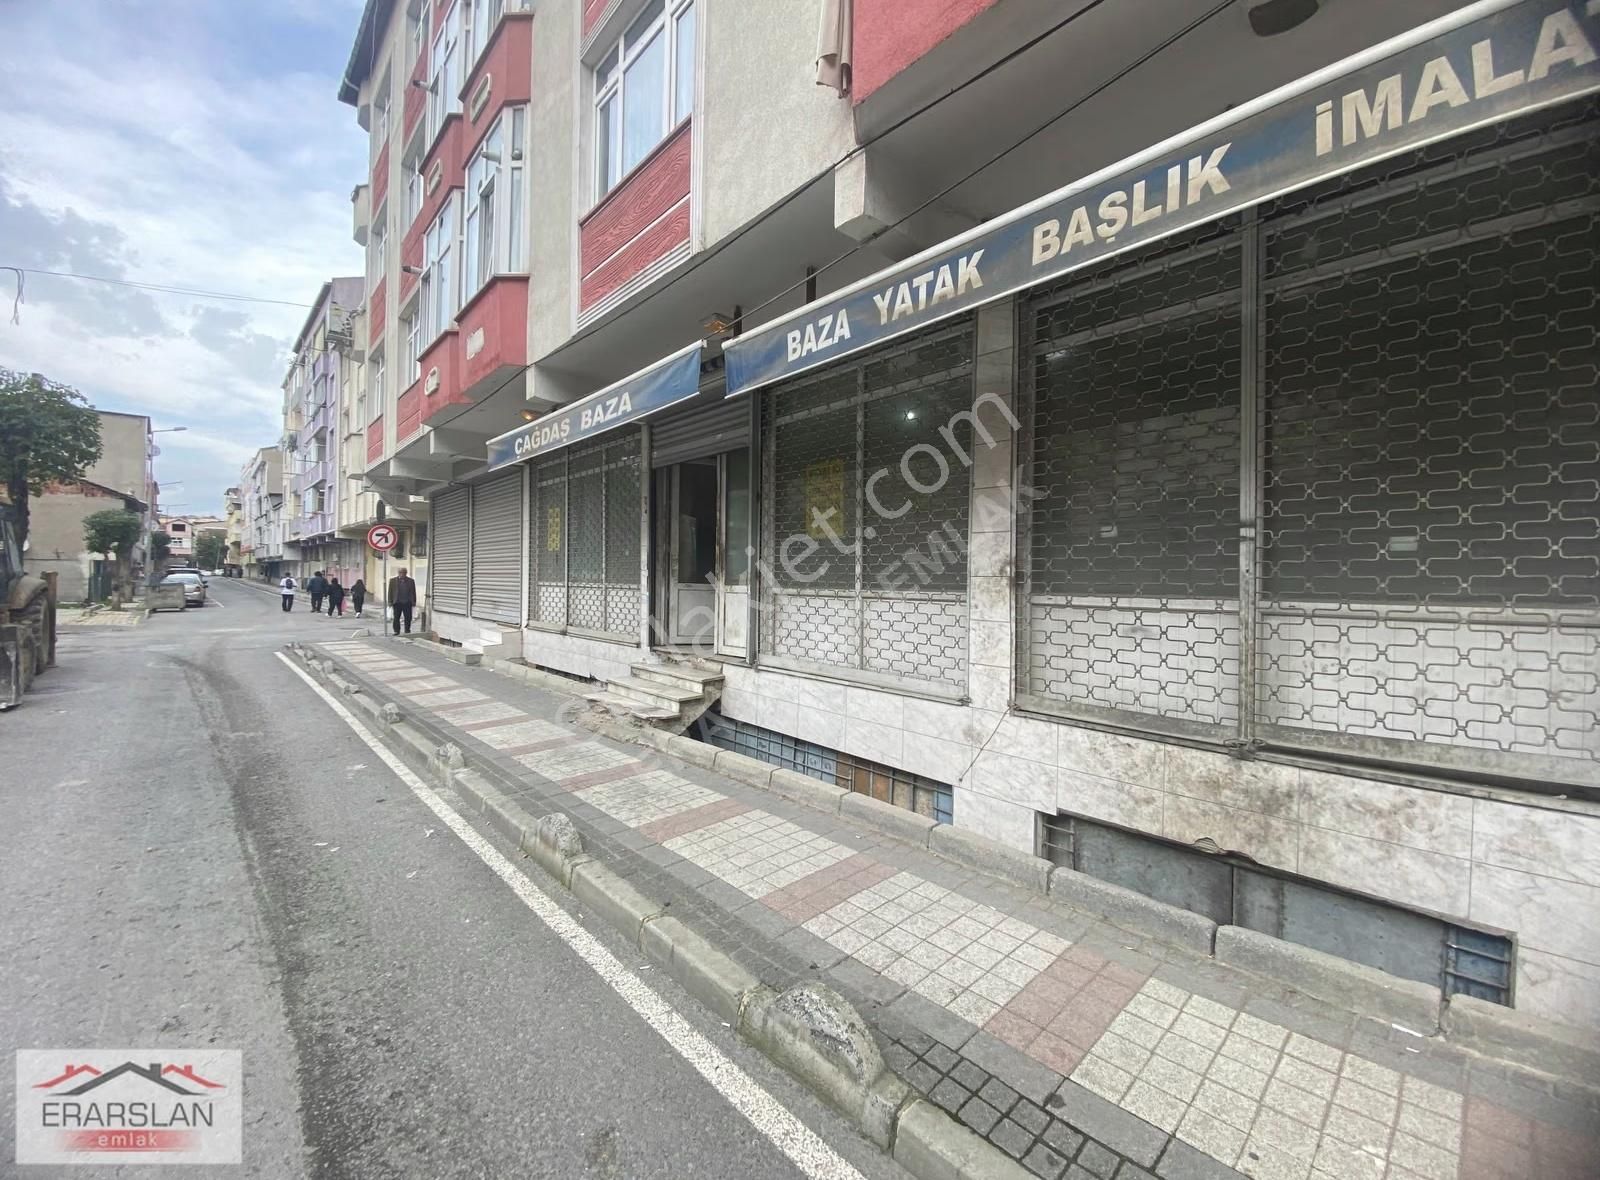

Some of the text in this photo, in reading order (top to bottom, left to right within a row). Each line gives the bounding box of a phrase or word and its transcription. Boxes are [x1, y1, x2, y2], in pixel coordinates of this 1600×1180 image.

[786, 0, 1600, 362] BAZA YATAK BAŞLIK İMALA
[514, 391, 632, 457] ÇAĞDAŞ BAZA
